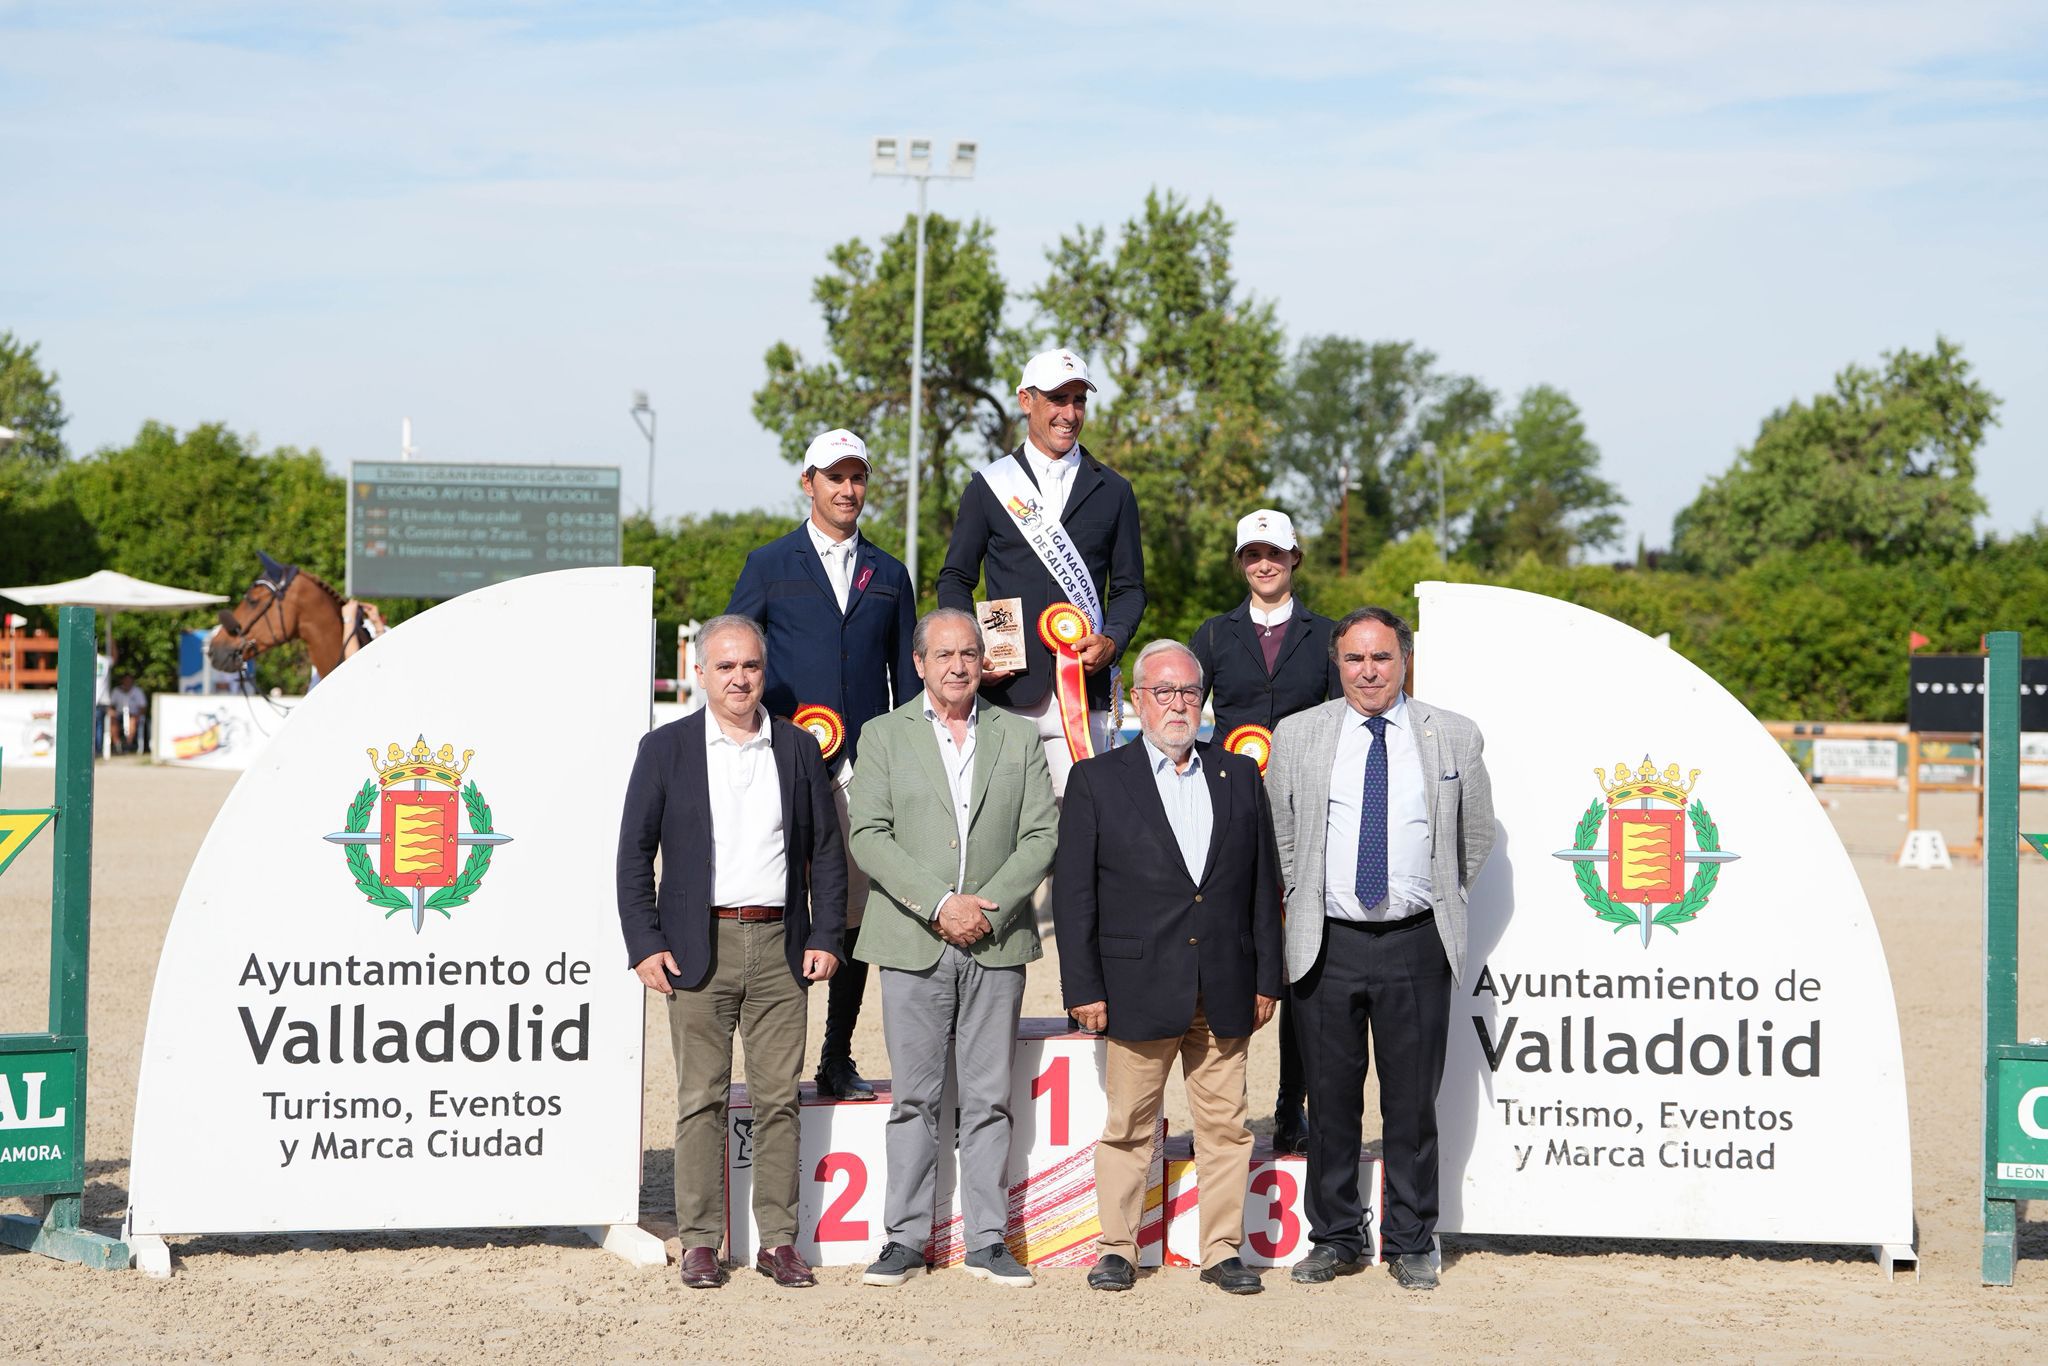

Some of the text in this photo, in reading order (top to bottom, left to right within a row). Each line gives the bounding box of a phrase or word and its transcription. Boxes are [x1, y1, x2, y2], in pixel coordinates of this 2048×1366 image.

[487, 488, 509, 502] DE
[1032, 534, 1048, 551] DE
[1044, 550, 1076, 593] SALTOS
[1045, 525, 1098, 612] LIGA NACIONAL
[239, 952, 590, 994] Ayuntamiento de
[1472, 964, 1821, 1005] Ayuntamiento de
[238, 1003, 589, 1064] Valladolid
[1472, 1016, 1820, 1077] Valladolid
[262, 1090, 562, 1123] Turismo, Eventos
[1032, 1056, 1070, 1146] 1
[1498, 1099, 1793, 1133] Turismo, Eventos
[280, 1128, 543, 1168] y Marca Ciudad
[1514, 1139, 1775, 1171] y Marca Ciudad
[815, 1152, 869, 1243] 2
[1248, 1169, 1301, 1259] 3
